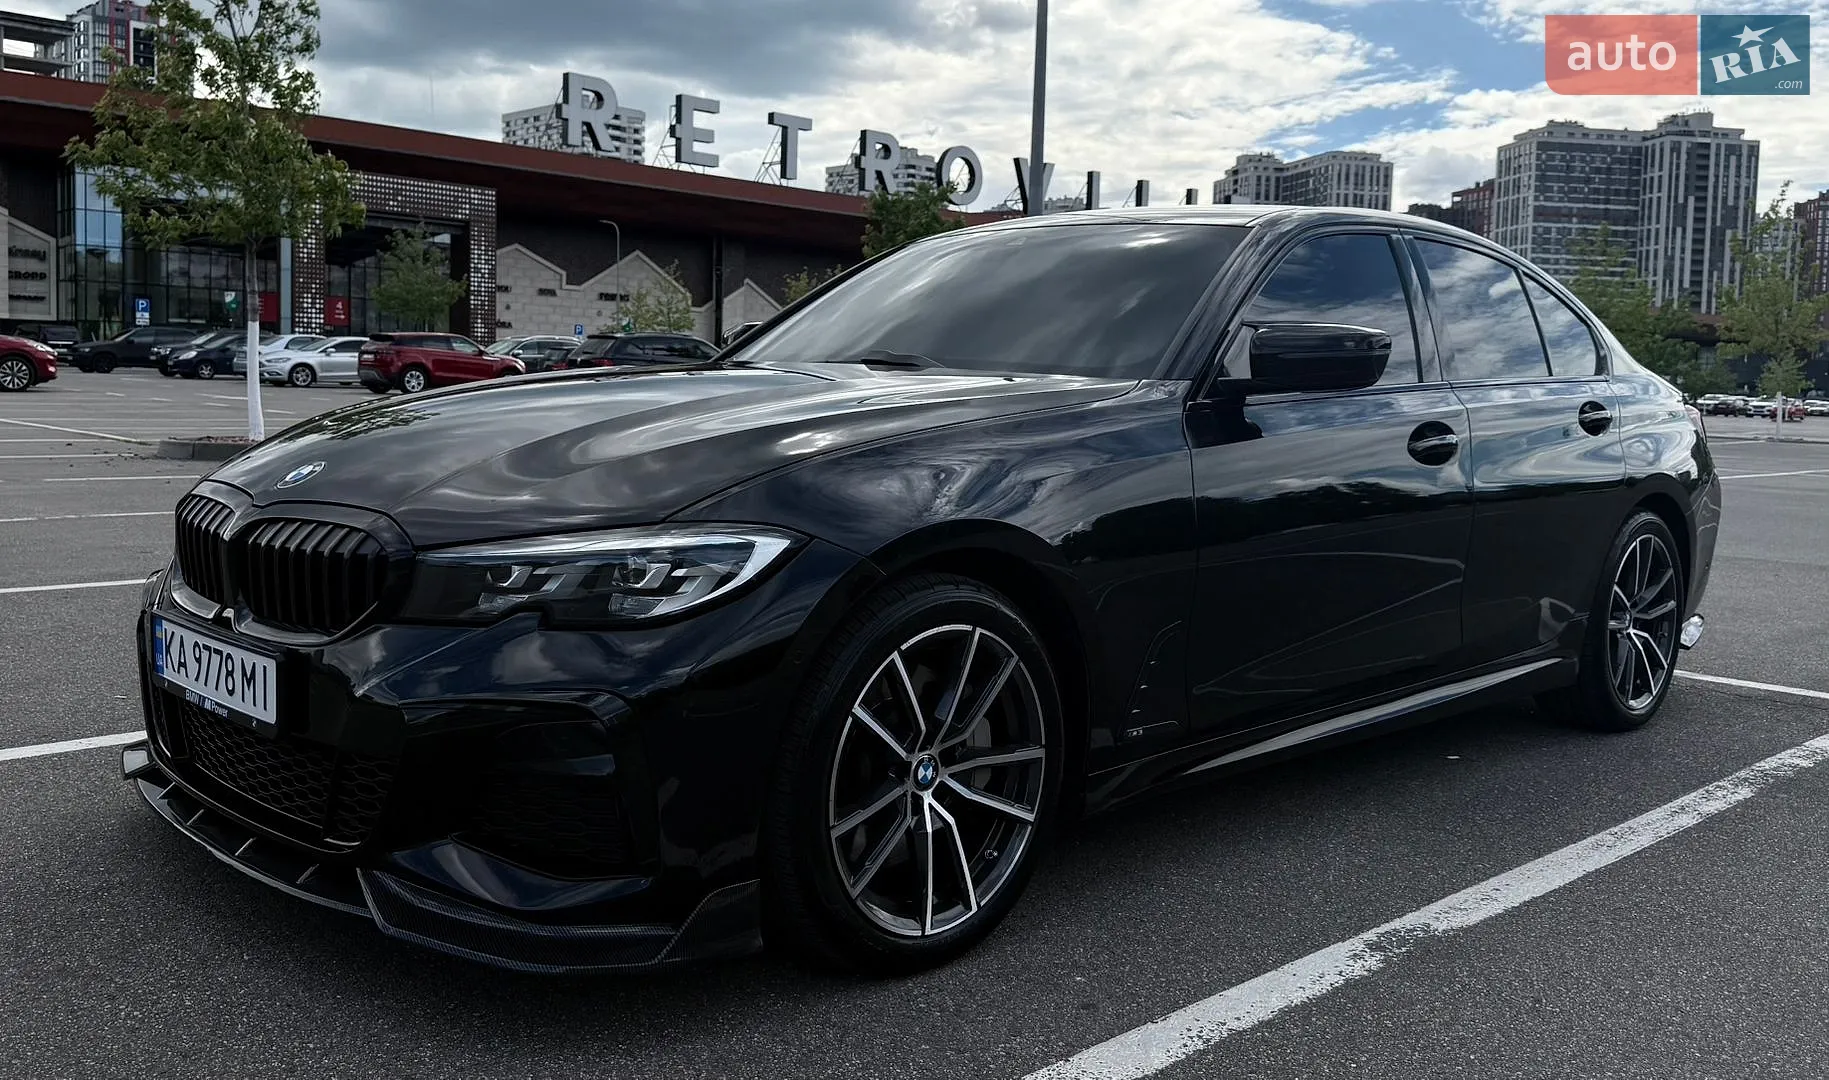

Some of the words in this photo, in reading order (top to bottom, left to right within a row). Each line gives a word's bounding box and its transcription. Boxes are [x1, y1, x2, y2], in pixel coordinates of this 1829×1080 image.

[164, 627, 189, 679] KA
[192, 640, 236, 697] 9778
[241, 657, 268, 711] MI
